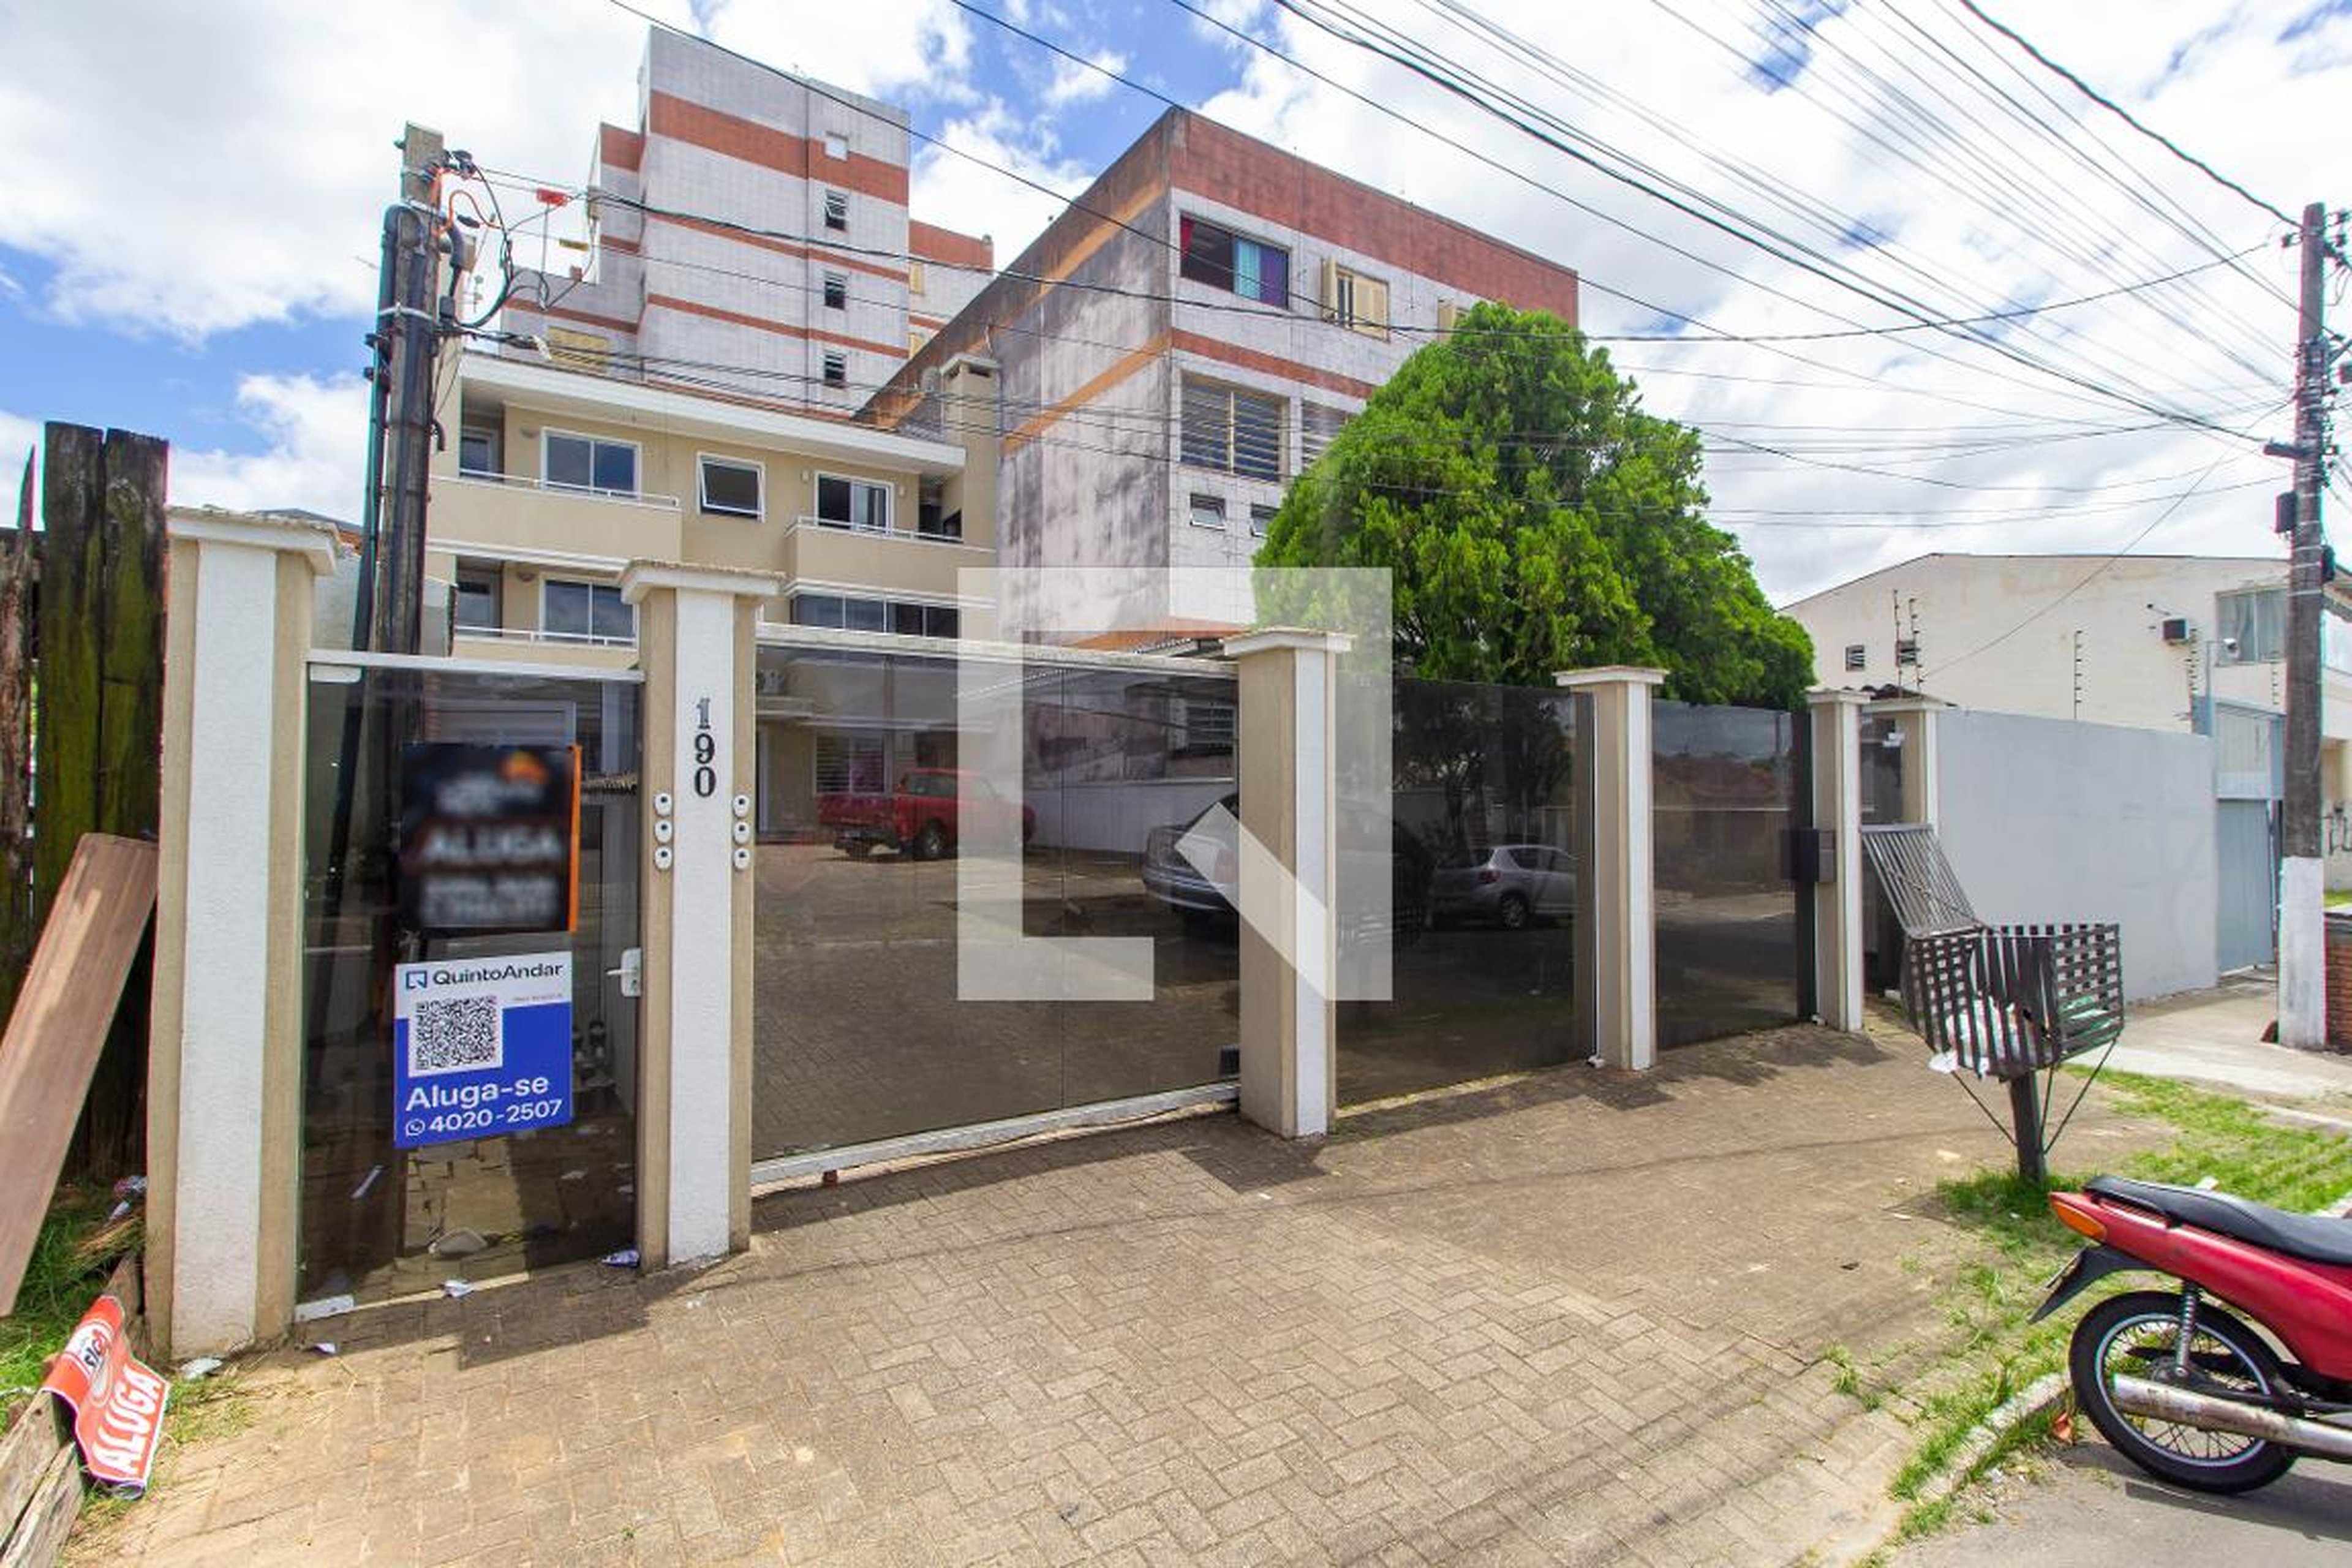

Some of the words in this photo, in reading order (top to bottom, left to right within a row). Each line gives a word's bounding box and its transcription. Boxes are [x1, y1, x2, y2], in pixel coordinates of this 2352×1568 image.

[694, 697, 716, 797] 190
[432, 963, 563, 985] QuintoAndar
[405, 1076, 549, 1112] Aluga-se
[429, 1099, 562, 1132] 4020-2507
[92, 1363, 162, 1474] ALUGA
